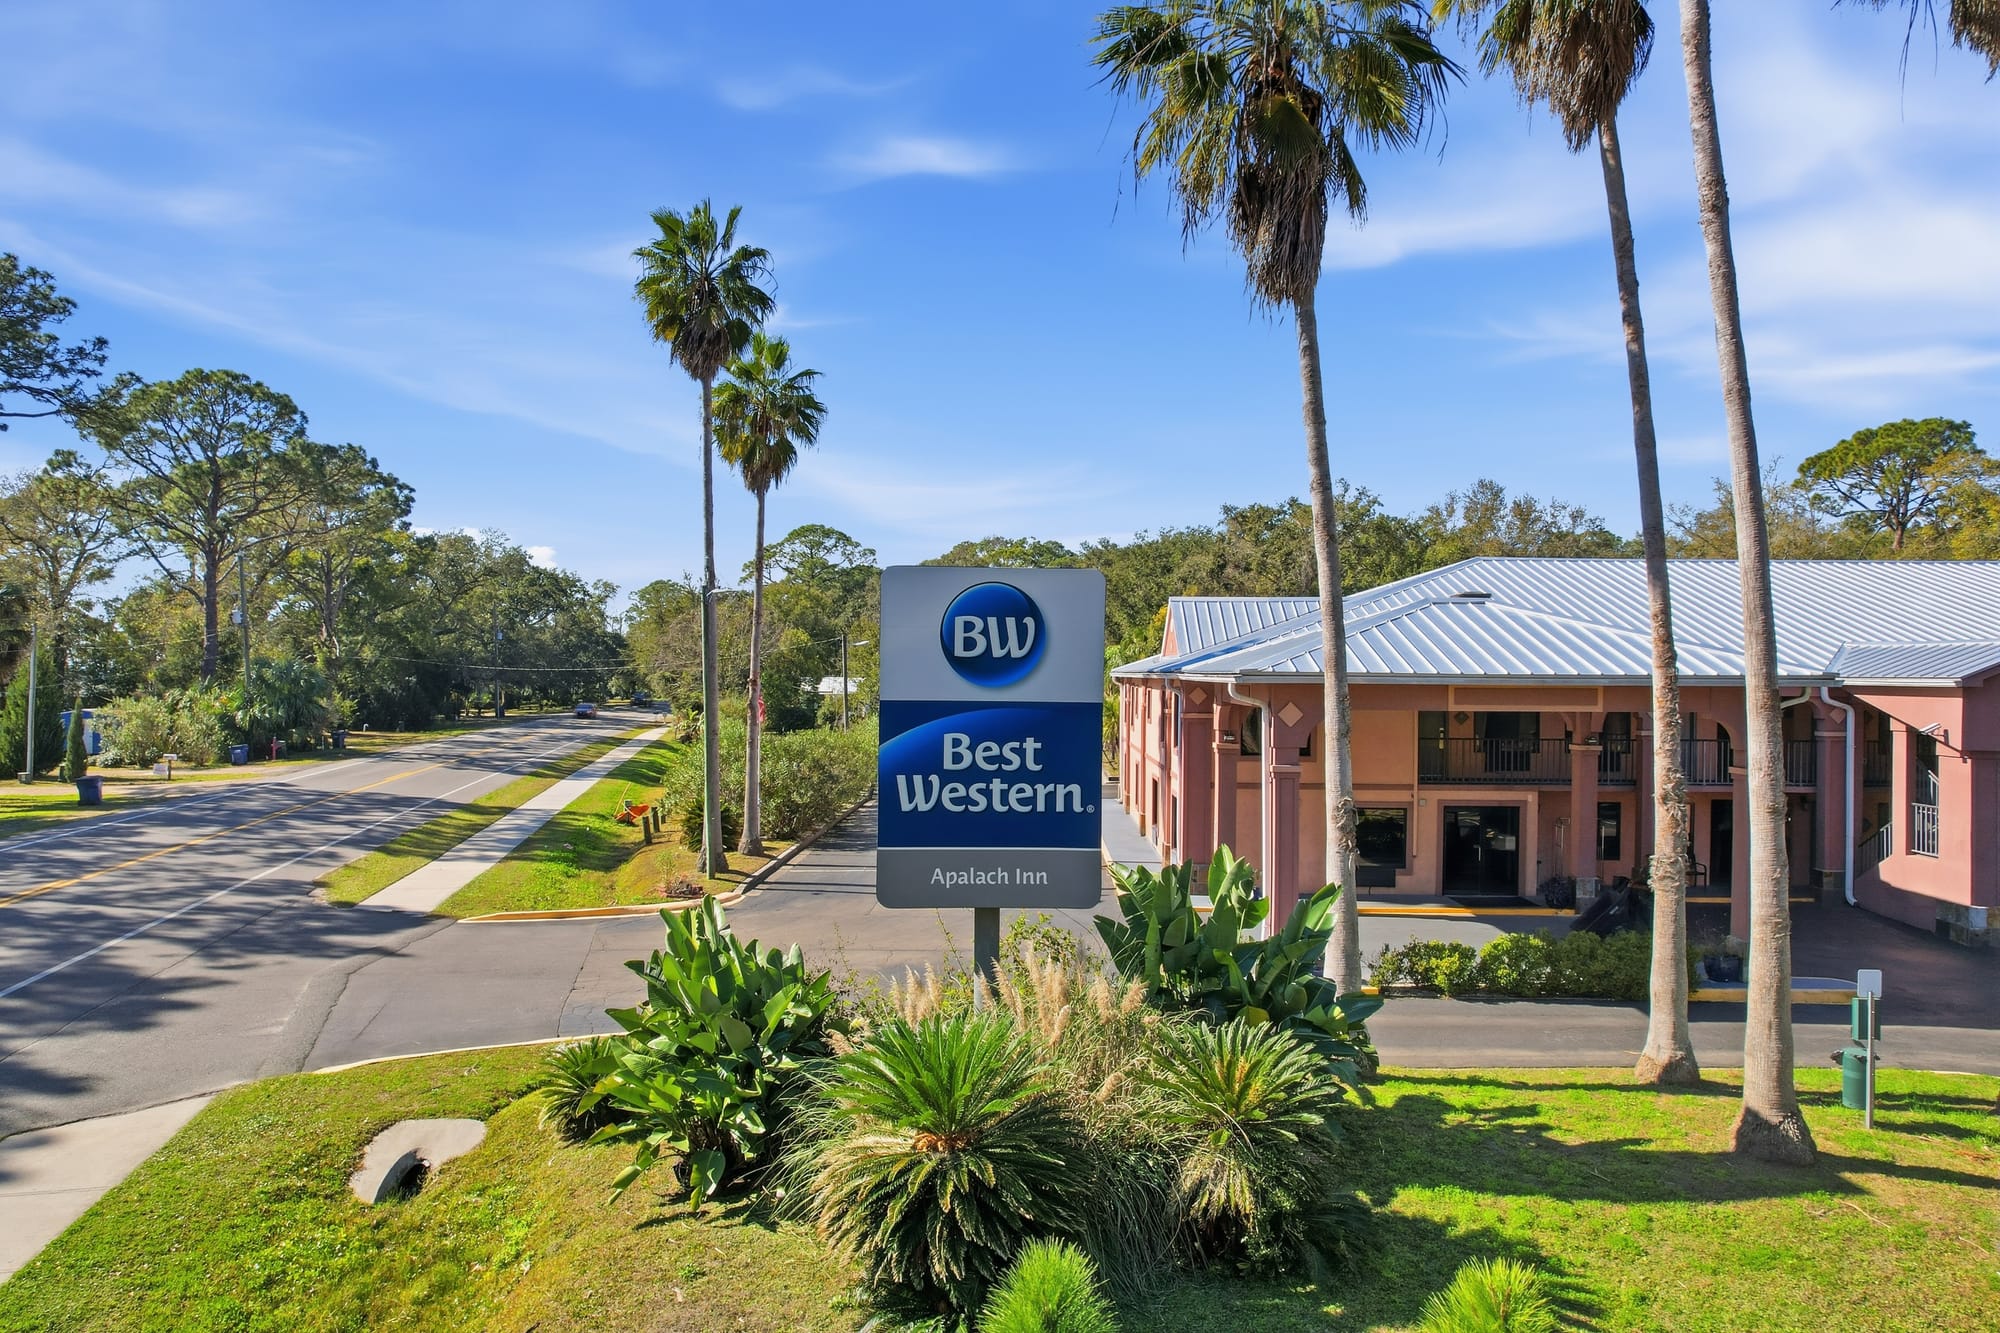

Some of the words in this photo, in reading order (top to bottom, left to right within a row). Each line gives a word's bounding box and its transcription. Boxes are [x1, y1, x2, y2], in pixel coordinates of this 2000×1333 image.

[953, 615, 1036, 658] BW
[943, 733, 1043, 772] Best
[896, 775, 1084, 814] Western
[930, 867, 1009, 888] Apalach
[1015, 868, 1048, 885] Inn
